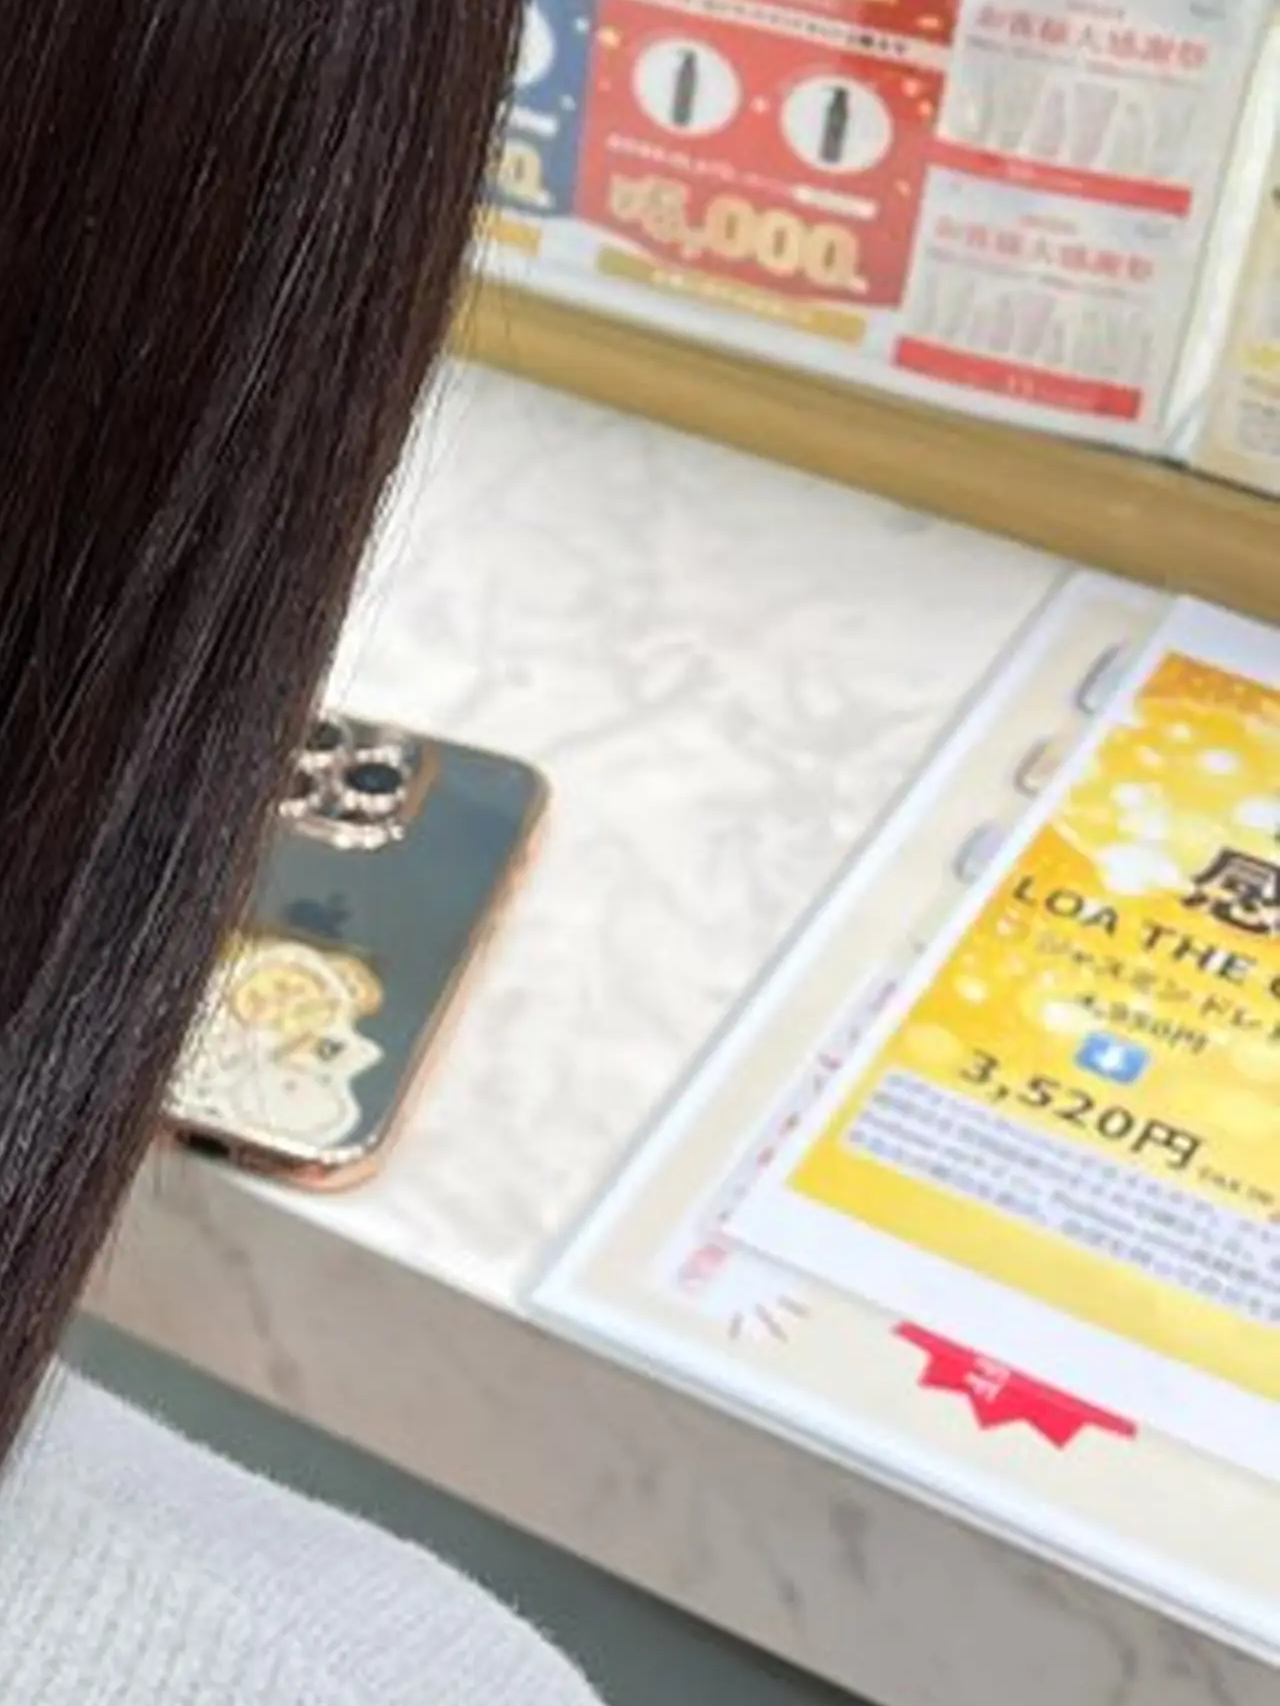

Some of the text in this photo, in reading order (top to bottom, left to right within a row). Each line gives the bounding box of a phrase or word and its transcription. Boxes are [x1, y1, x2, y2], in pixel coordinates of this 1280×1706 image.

[1012, 875, 1259, 985] LOA THE
[957, 1047, 1204, 1171] 3,520円
